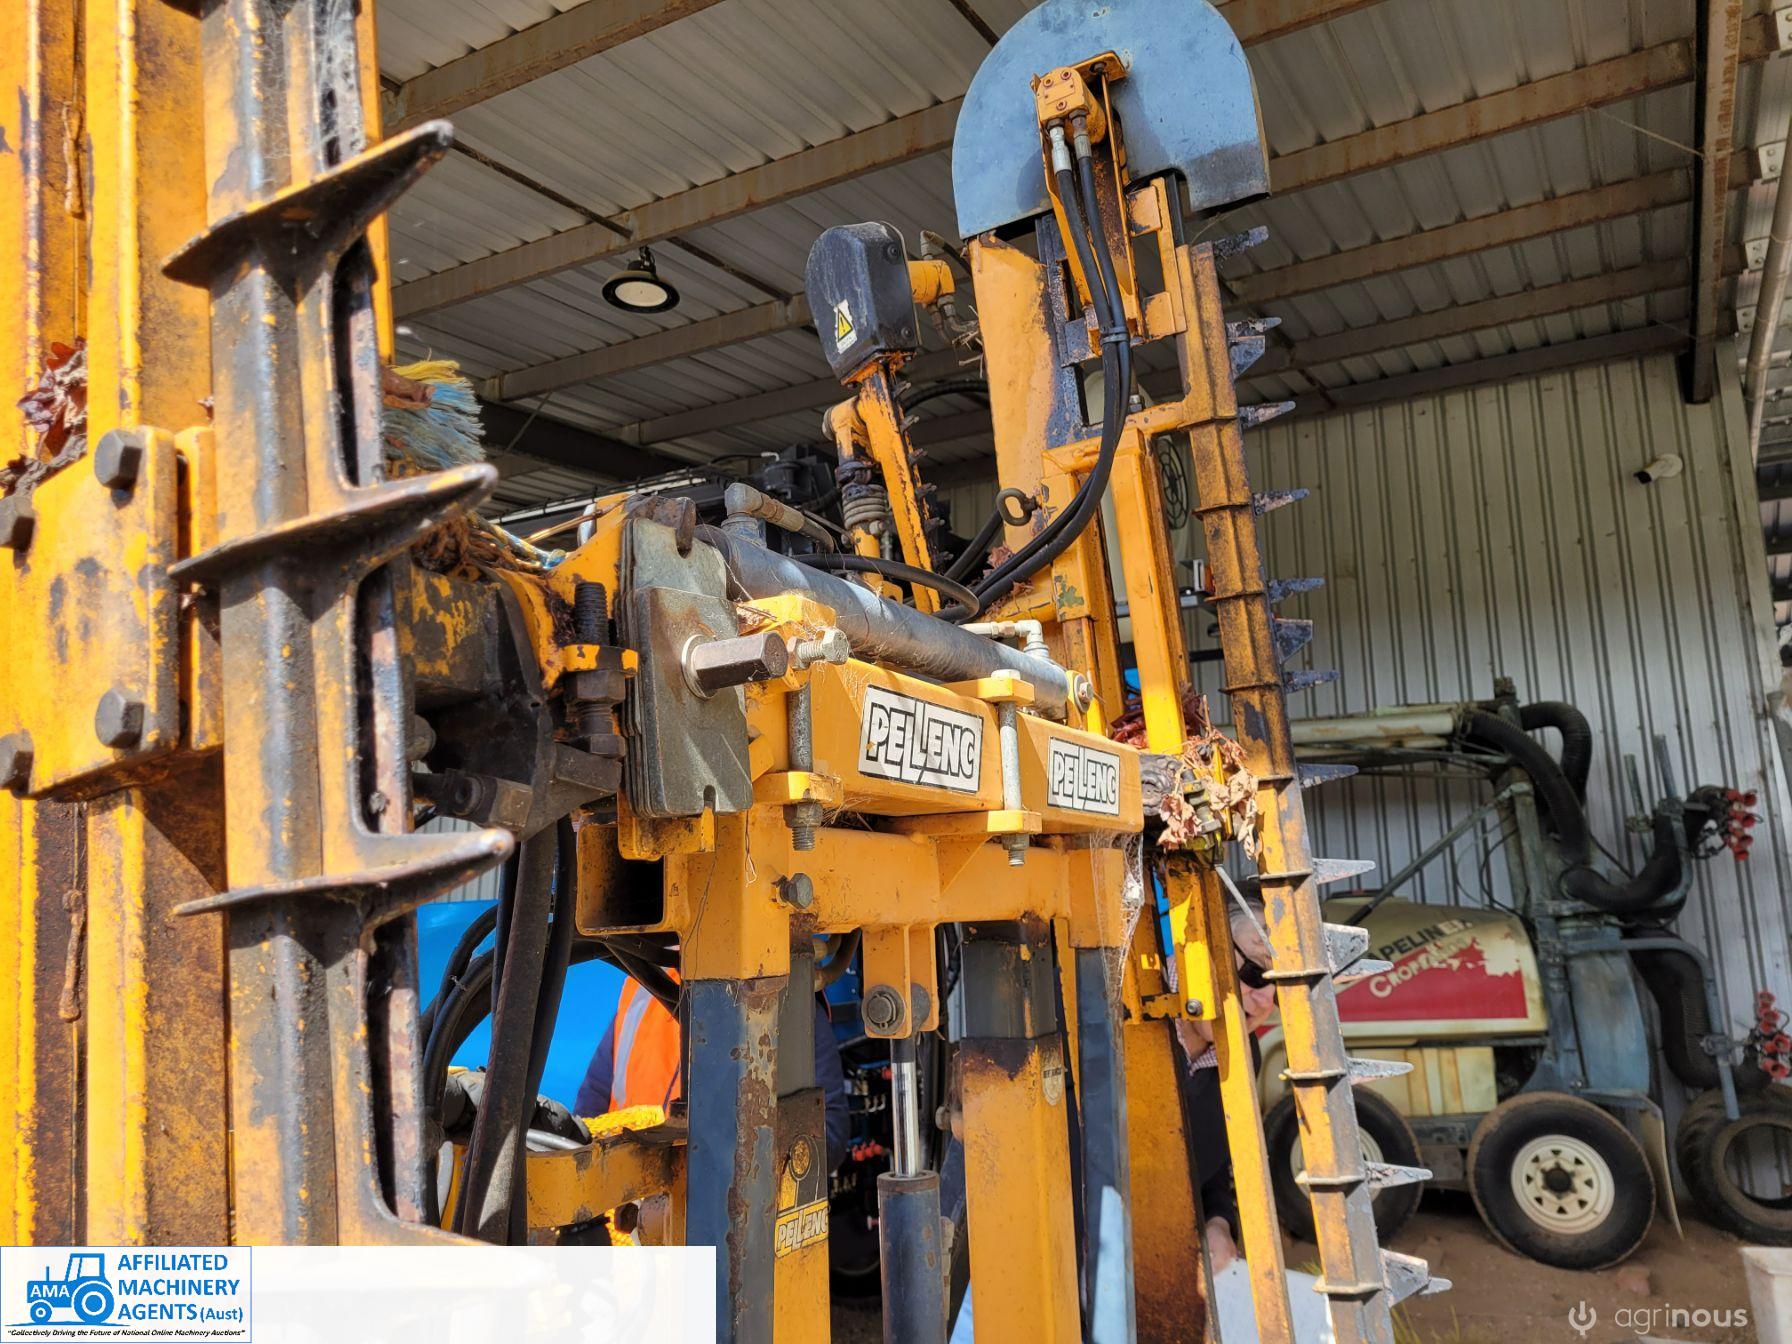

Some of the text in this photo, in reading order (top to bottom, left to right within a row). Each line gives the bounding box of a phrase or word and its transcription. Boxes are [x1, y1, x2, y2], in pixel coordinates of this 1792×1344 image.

[867, 701, 975, 783] PELLENC
[1052, 746, 1117, 807] PELLENC
[777, 1208, 829, 1252] PELLENC
